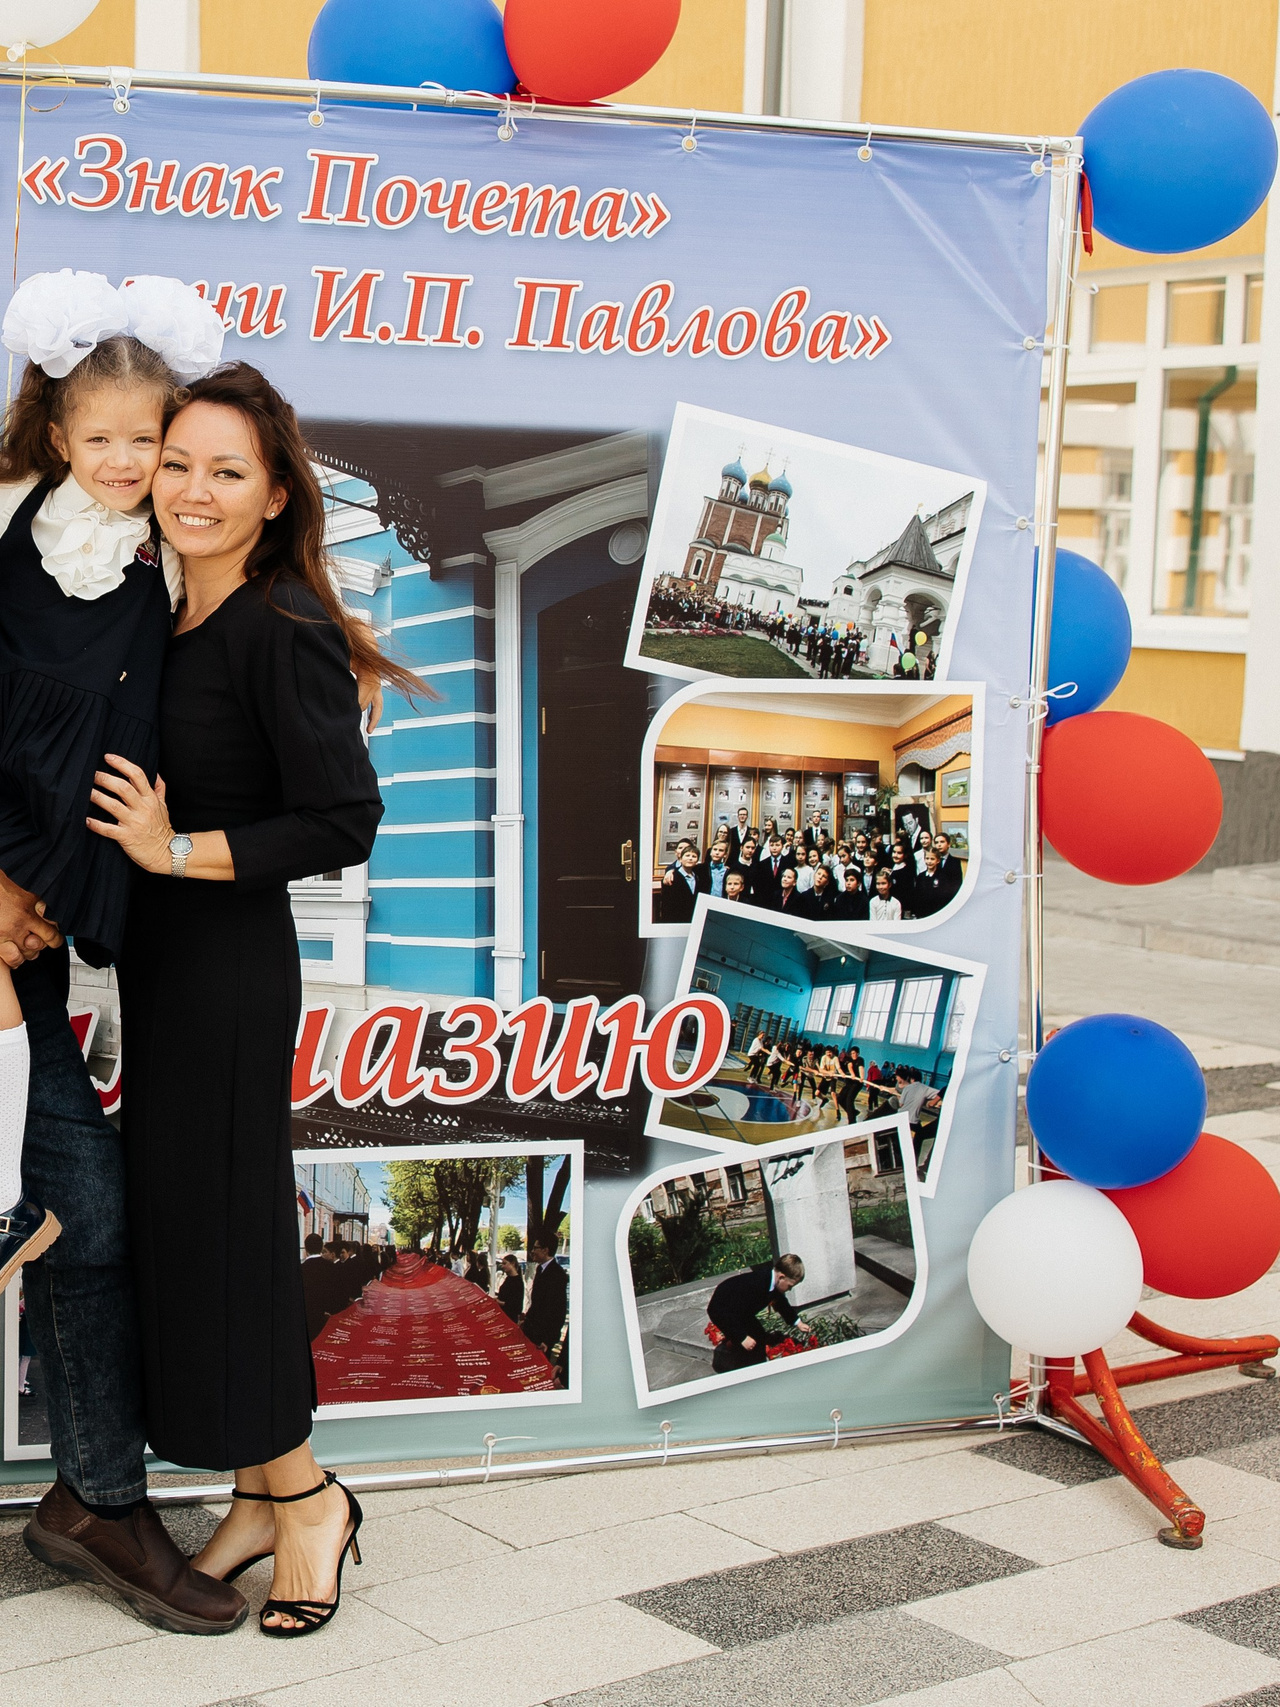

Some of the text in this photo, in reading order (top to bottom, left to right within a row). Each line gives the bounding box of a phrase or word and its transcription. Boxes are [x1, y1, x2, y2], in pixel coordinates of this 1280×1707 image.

[22, 135, 281, 220] «Знак
[300, 150, 669, 240] Почета»
[311, 268, 482, 347] И.П.
[507, 279, 891, 362] Павлова»
